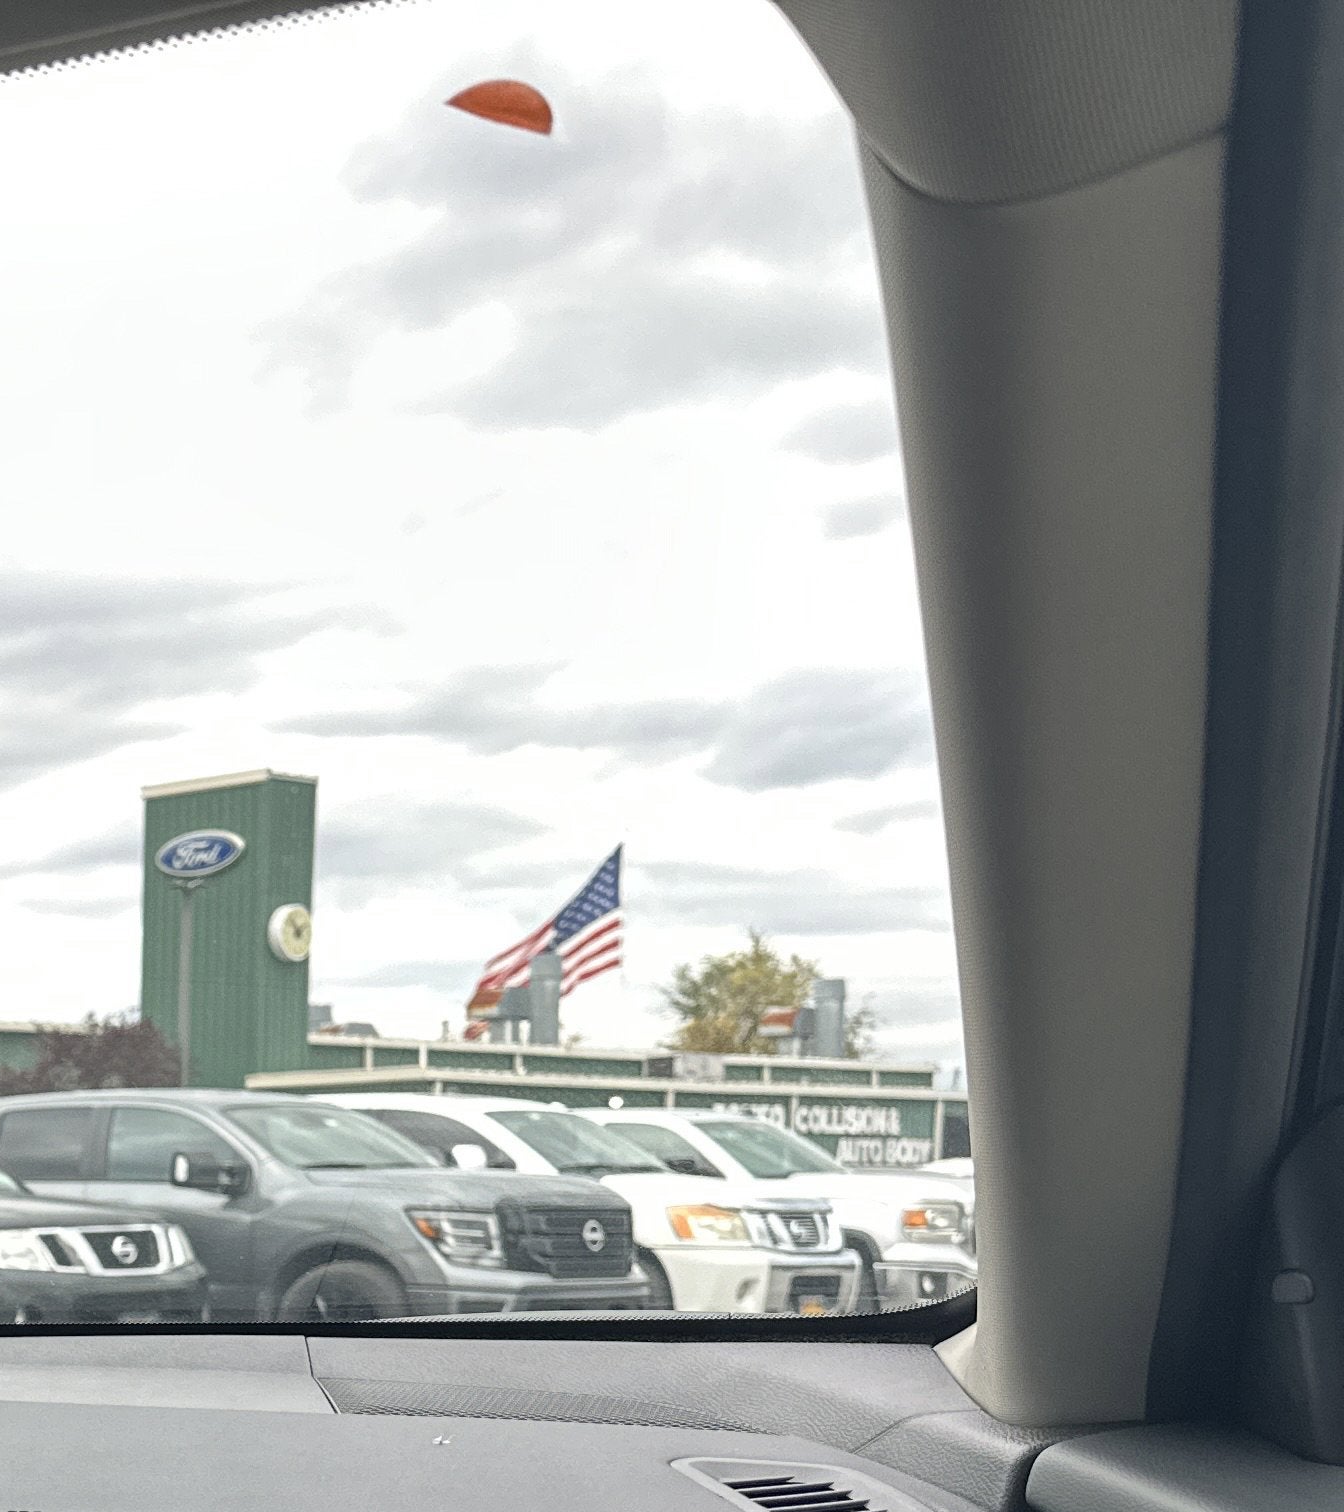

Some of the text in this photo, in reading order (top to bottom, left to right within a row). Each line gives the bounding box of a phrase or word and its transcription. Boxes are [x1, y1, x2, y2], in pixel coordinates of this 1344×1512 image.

[172, 840, 223, 870] Ford
[796, 1104, 885, 1135] COLLISION
[836, 1136, 932, 1164] AUTO BODY
